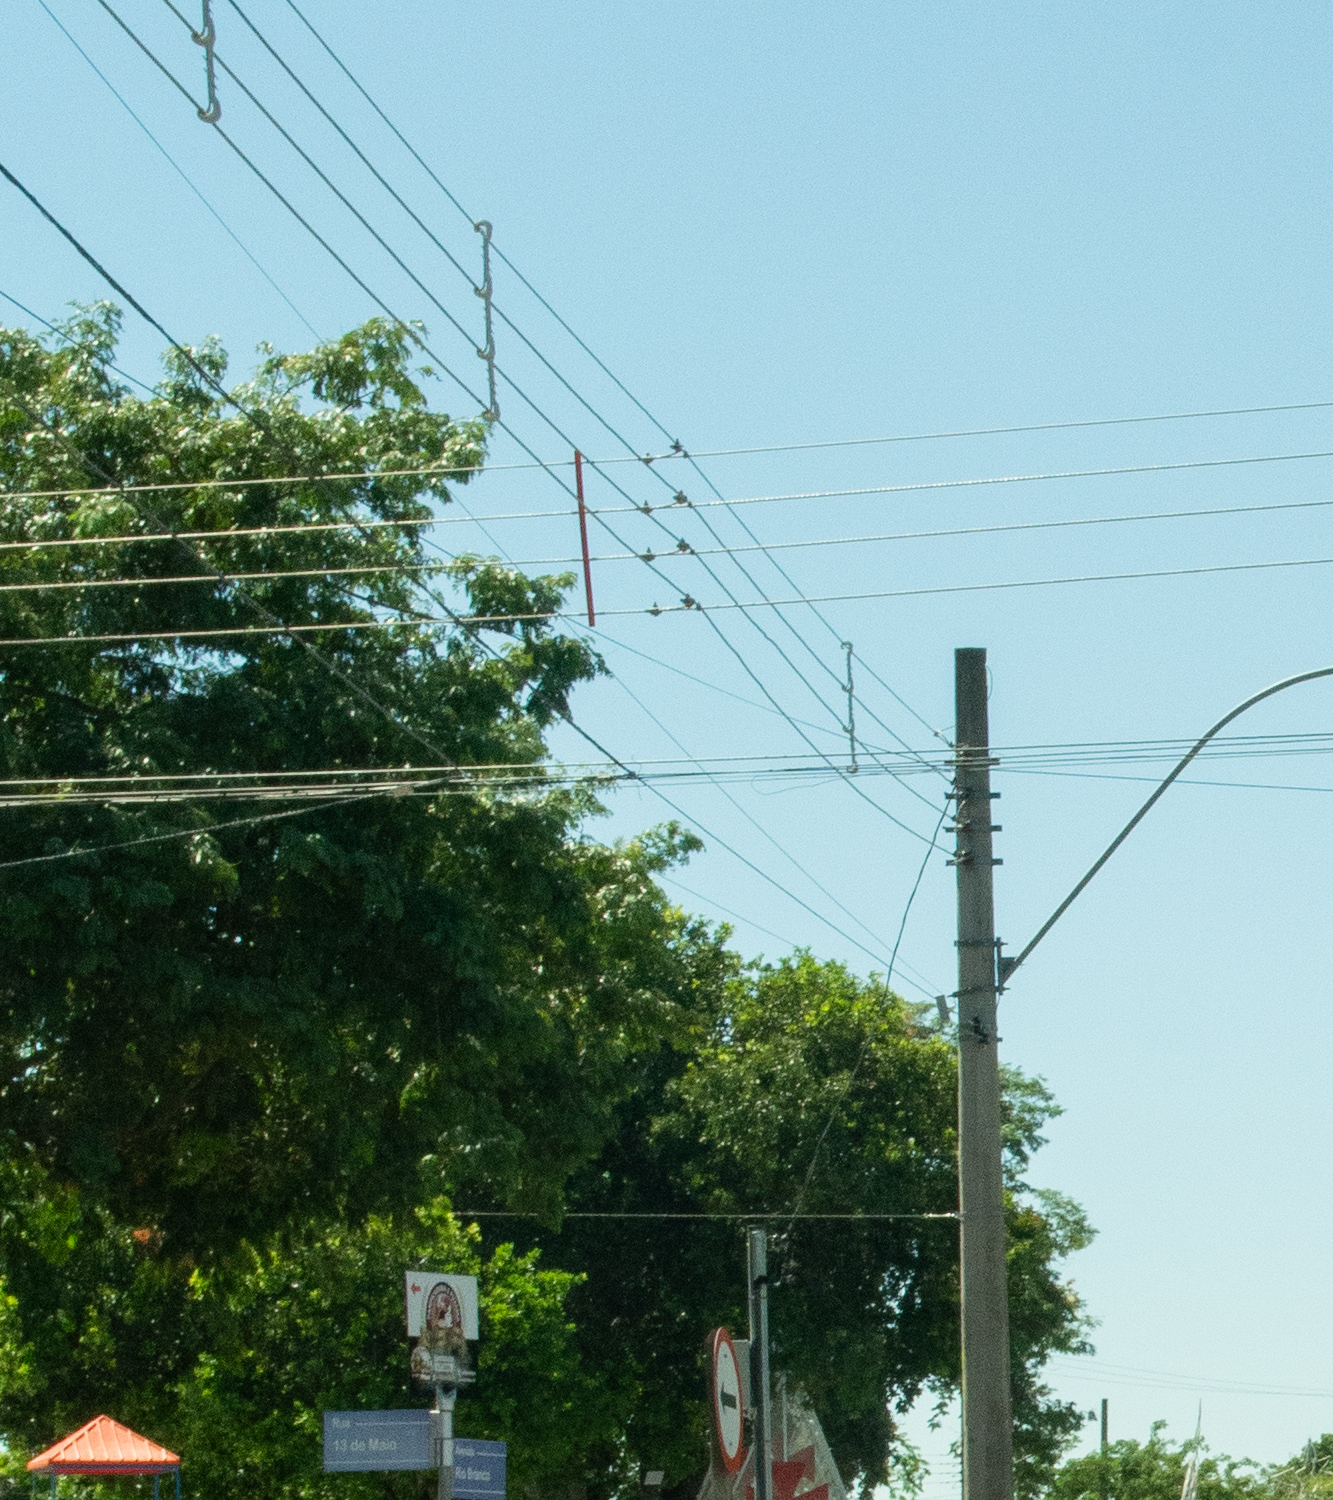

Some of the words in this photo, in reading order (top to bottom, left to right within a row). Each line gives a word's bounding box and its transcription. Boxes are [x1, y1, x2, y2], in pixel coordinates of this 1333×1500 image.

[334, 1438, 347, 1452] 13
[350, 1437, 366, 1452] de
[368, 1437, 397, 1452] Maio
